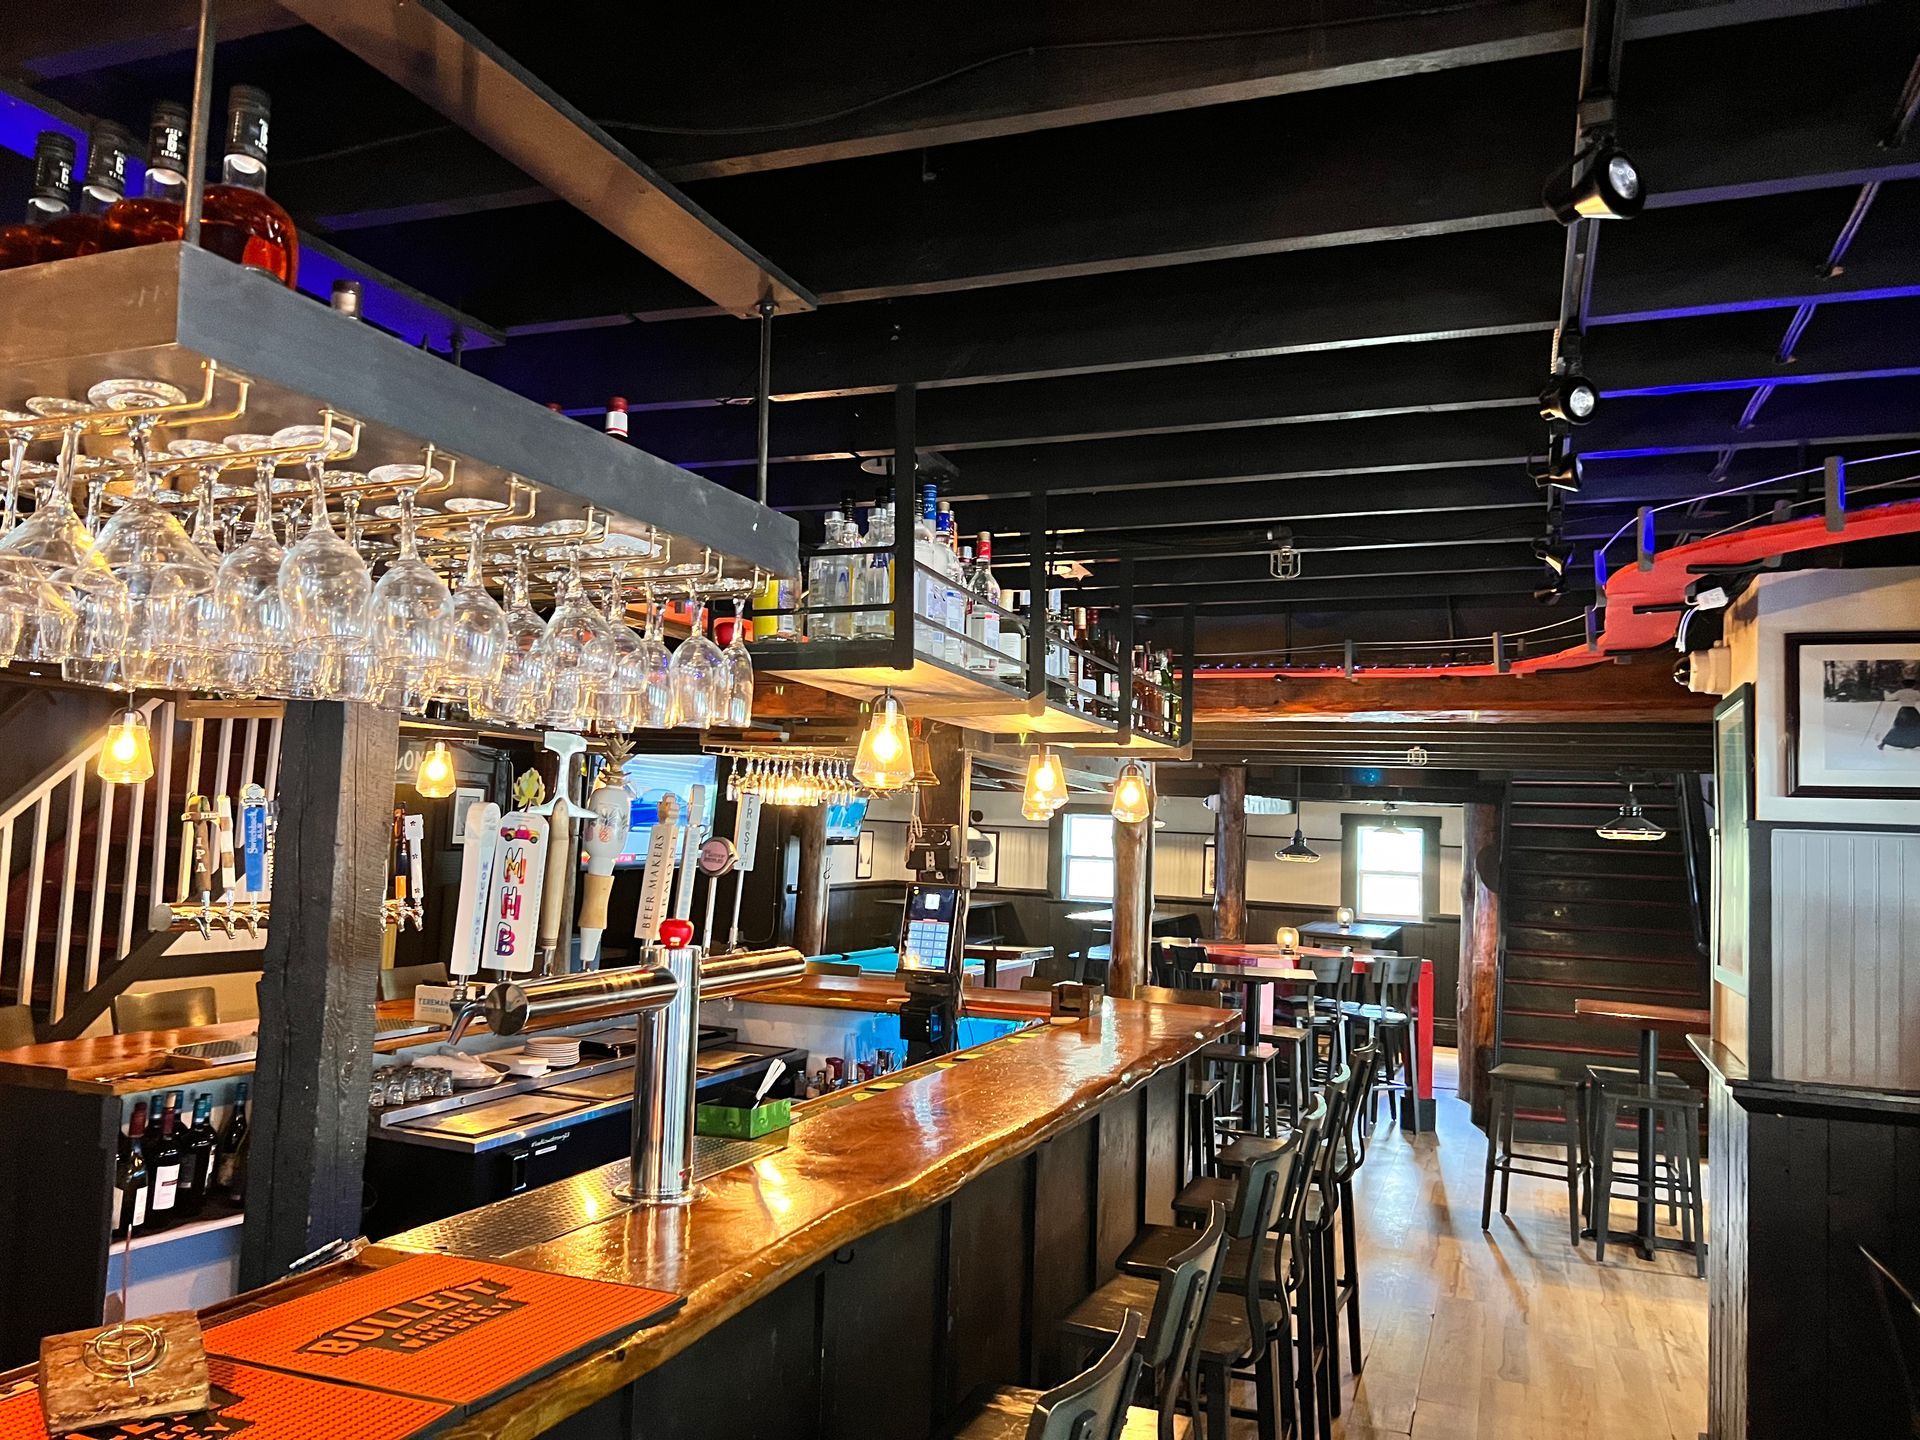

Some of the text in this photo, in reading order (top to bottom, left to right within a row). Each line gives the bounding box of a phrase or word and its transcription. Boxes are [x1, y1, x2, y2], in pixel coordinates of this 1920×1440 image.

[166, 133, 178, 152] 6
[61, 167, 70, 185] 6
[115, 156, 125, 175] 6
[195, 837, 208, 873] IPA
[641, 834, 664, 930] BEER MAKERS
[306, 1280, 497, 1355] BULLEIT
[391, 1303, 484, 1341] FRONTIER
[399, 1301, 513, 1349] WHISKEY
